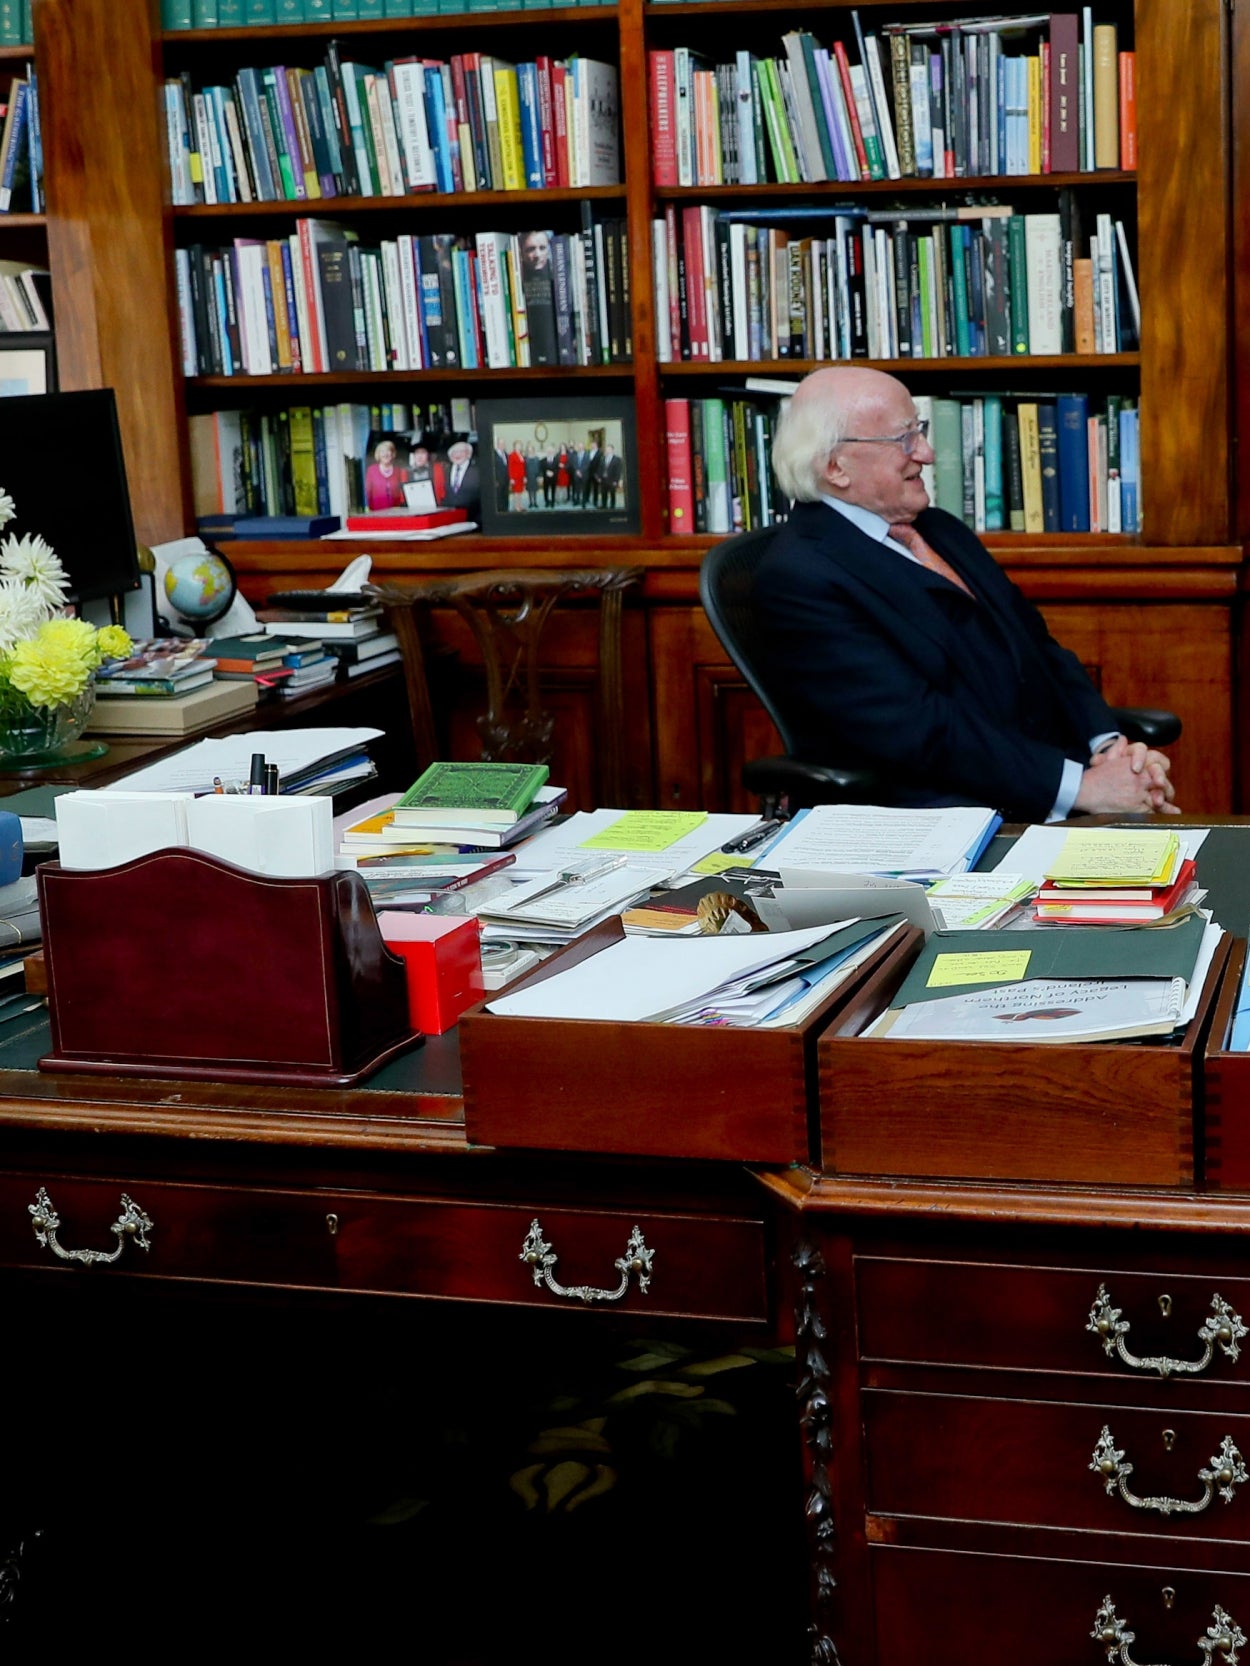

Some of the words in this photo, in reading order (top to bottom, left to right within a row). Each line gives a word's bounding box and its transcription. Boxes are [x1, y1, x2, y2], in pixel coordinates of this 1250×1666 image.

[556, 242, 566, 271] BRIAN
[583, 229, 595, 279] TRIBE
[790, 246, 801, 267] DAN
[790, 270, 802, 313] ROONEY
[991, 985, 1028, 996] Past
[1047, 990, 1063, 1000] of
[1068, 983, 1130, 998] Legacy
[961, 993, 1043, 1005] Northern
[976, 1001, 1007, 1011] the
[1012, 994, 1109, 1009] Addressing
